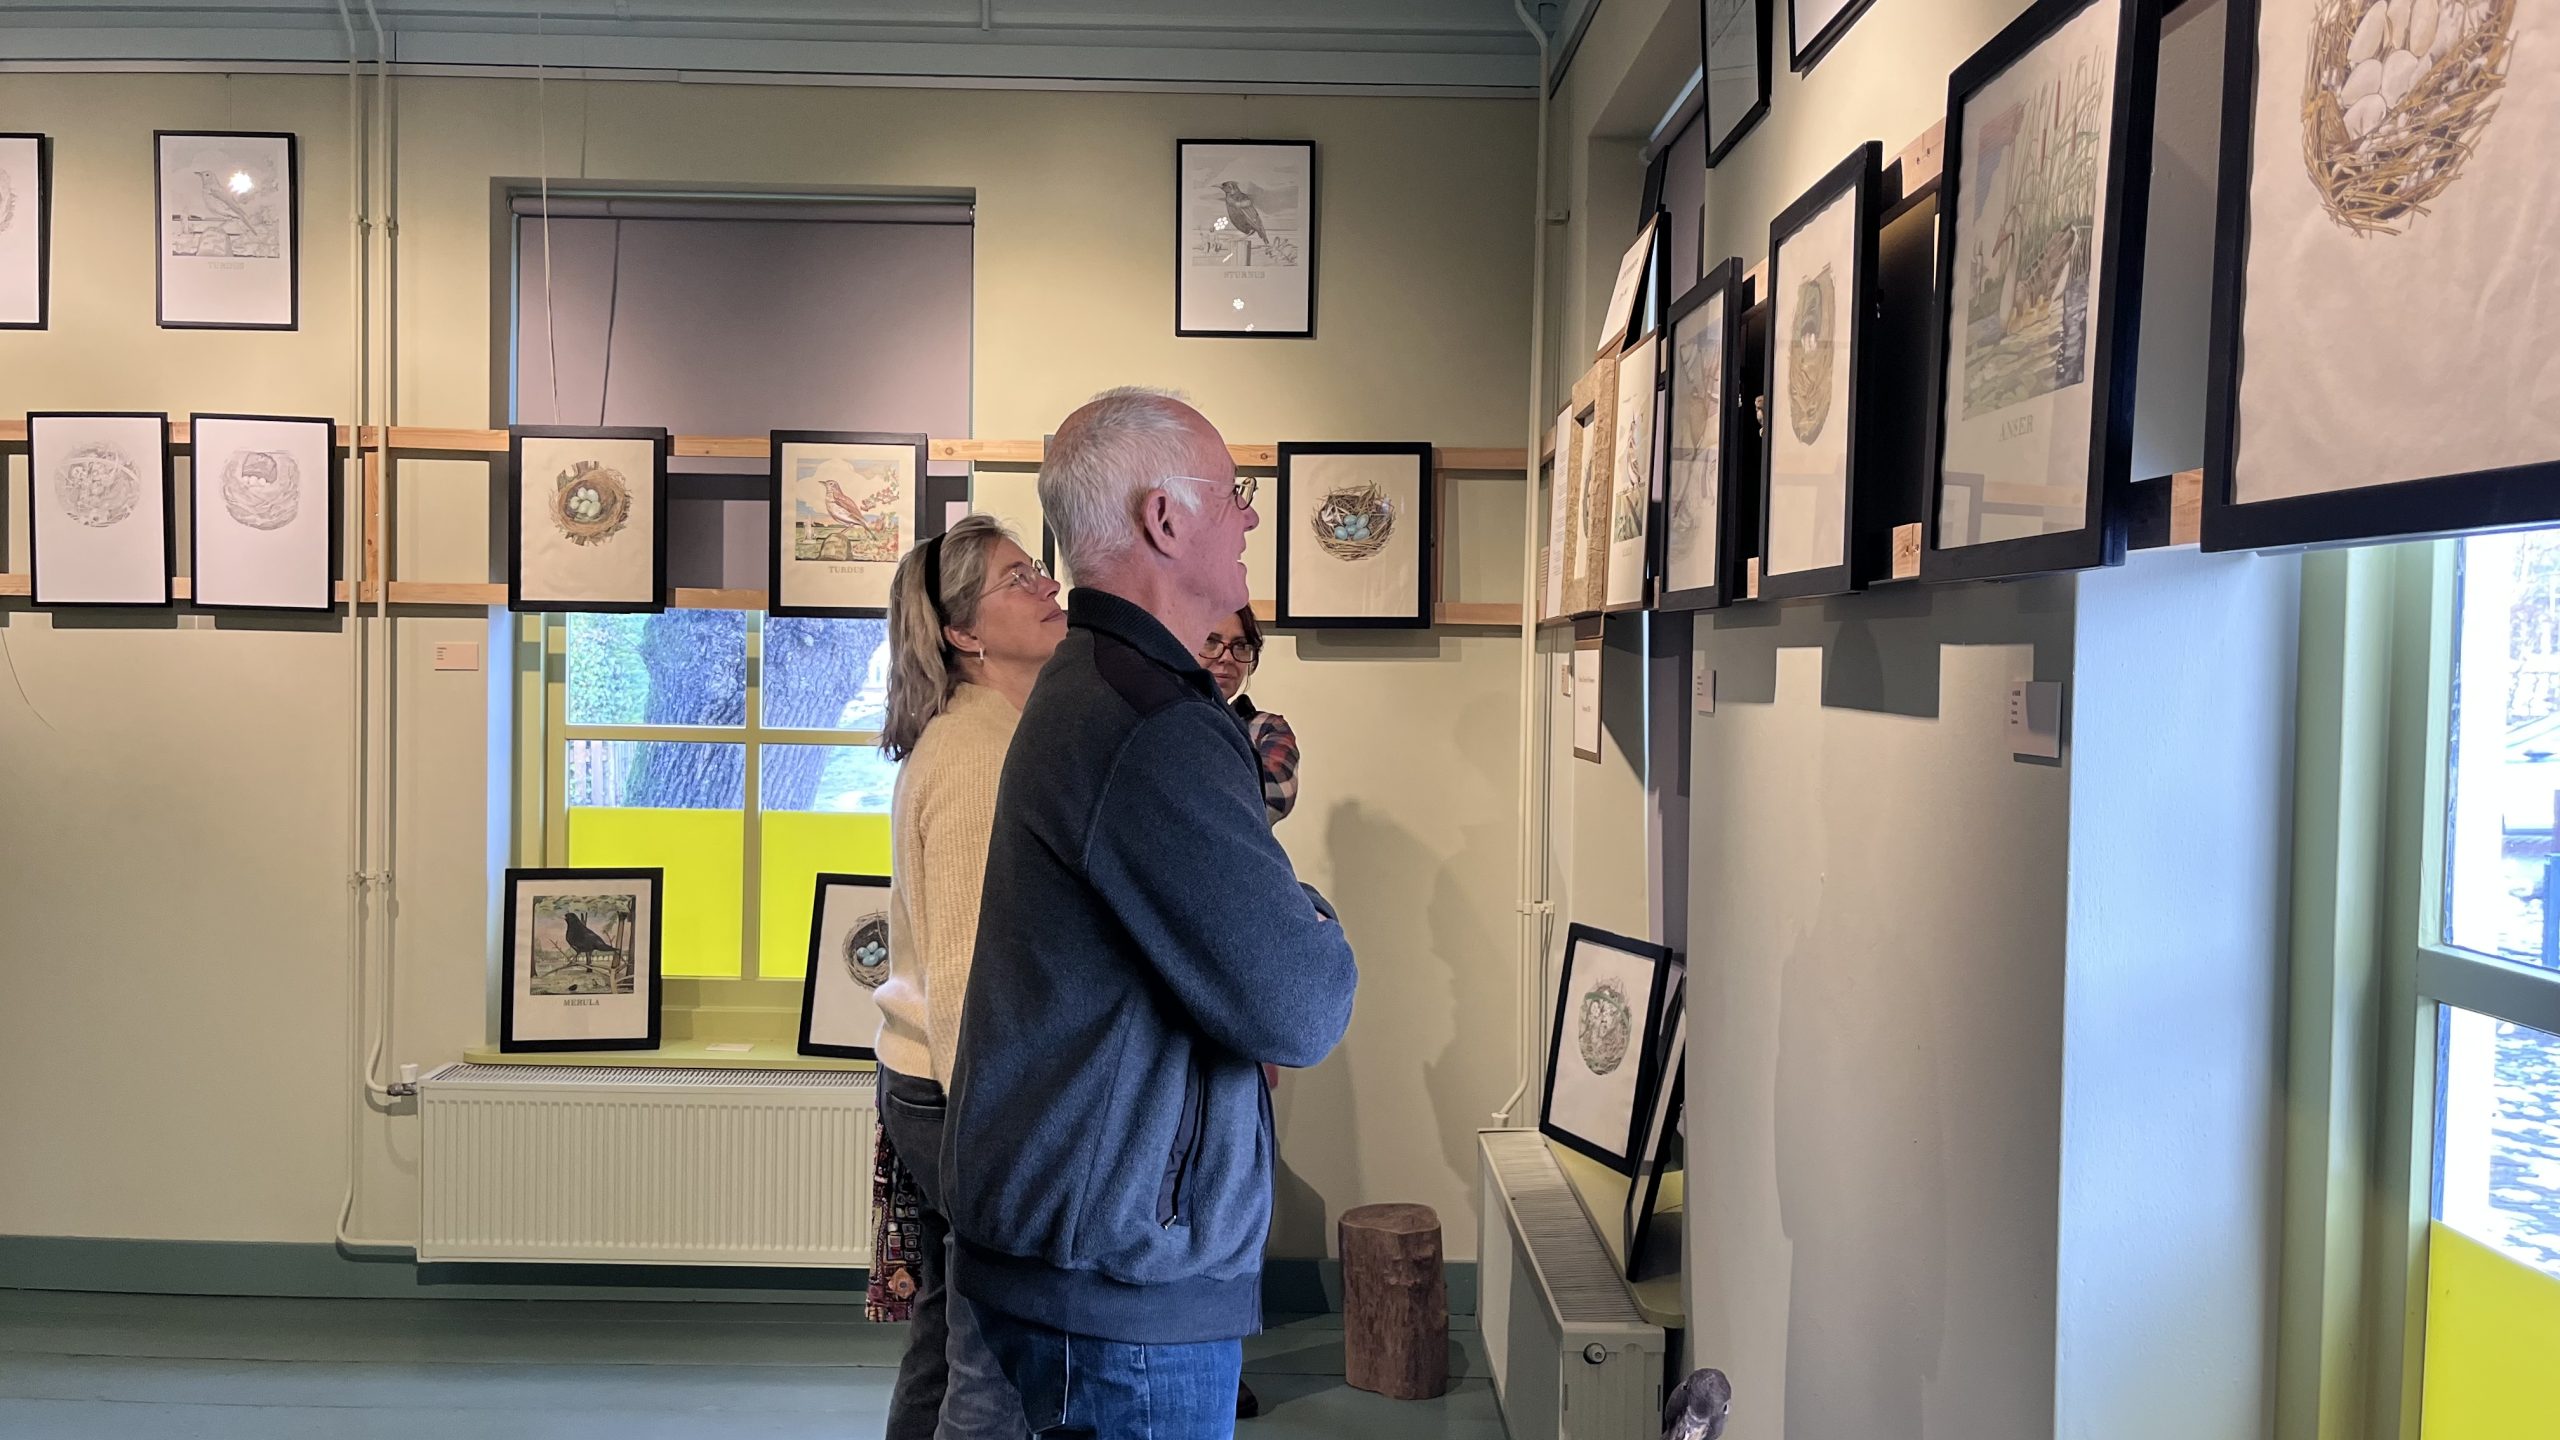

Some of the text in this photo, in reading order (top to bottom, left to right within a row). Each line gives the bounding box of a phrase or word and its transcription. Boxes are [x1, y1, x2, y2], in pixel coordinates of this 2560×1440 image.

[1998, 414, 2034, 442] ANSER
[828, 565, 865, 575] TURDUS
[563, 999, 601, 1007] MERULA
